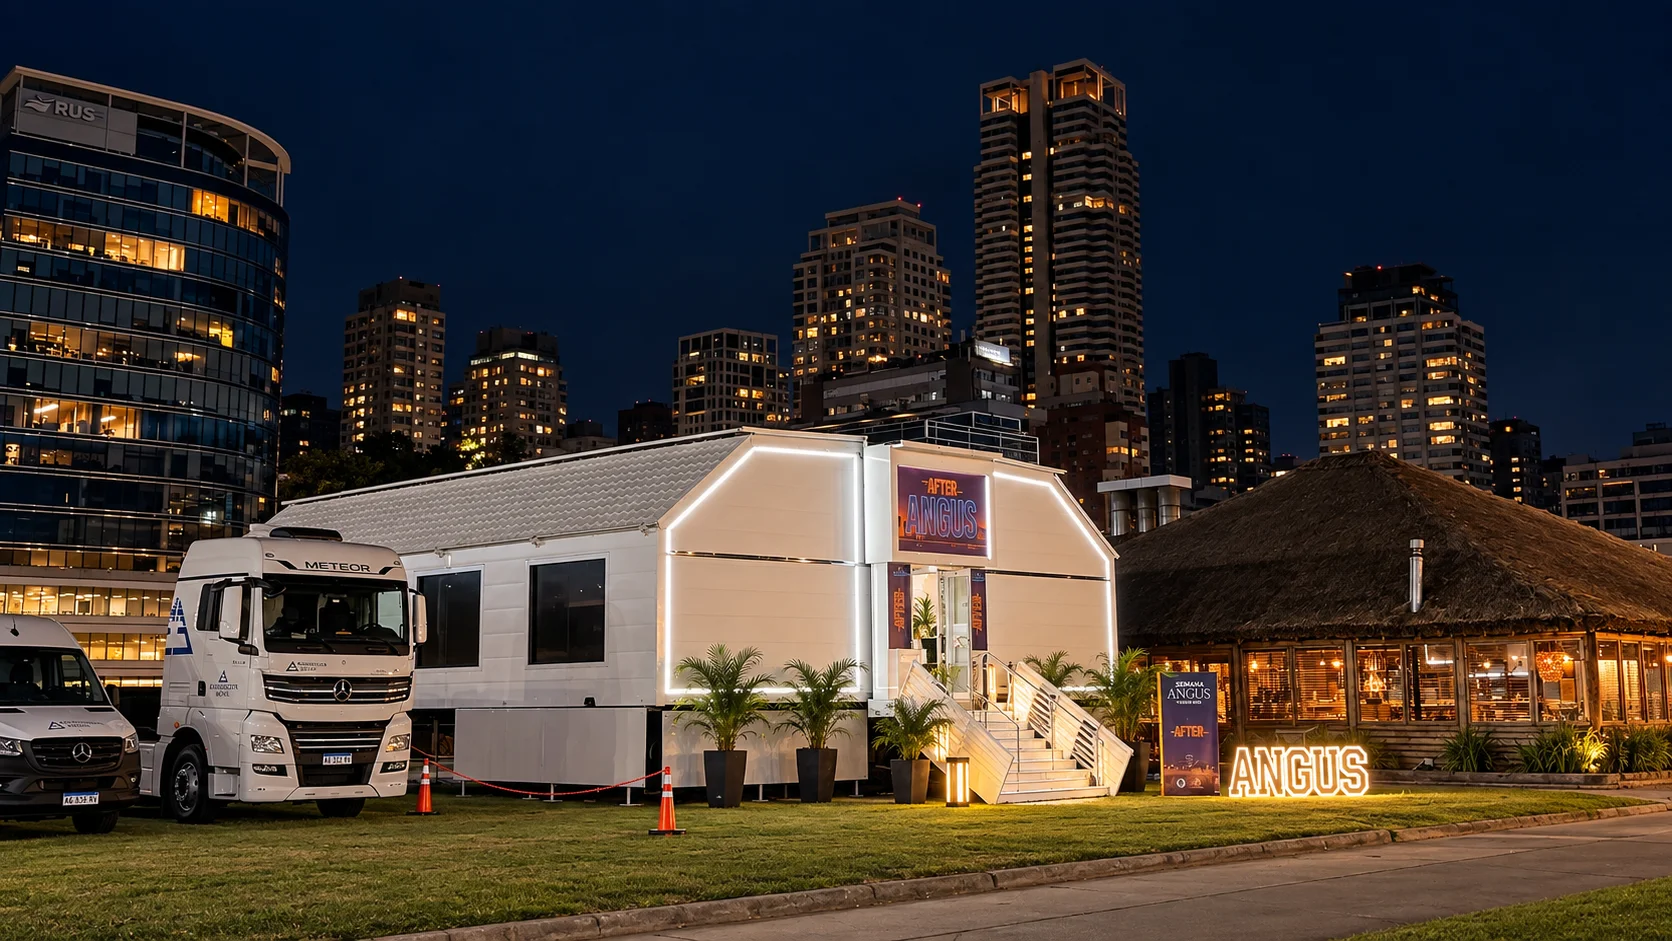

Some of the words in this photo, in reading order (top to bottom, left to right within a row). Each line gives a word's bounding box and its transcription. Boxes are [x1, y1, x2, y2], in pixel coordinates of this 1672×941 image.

[55, 101, 95, 122] RUS
[927, 477, 958, 496] AFTER
[905, 494, 978, 539] ANGUS
[304, 561, 371, 573] METEOR
[1167, 687, 1211, 700] ANGUS
[1173, 725, 1204, 737] AFTER
[1228, 745, 1370, 797] ANGUS
